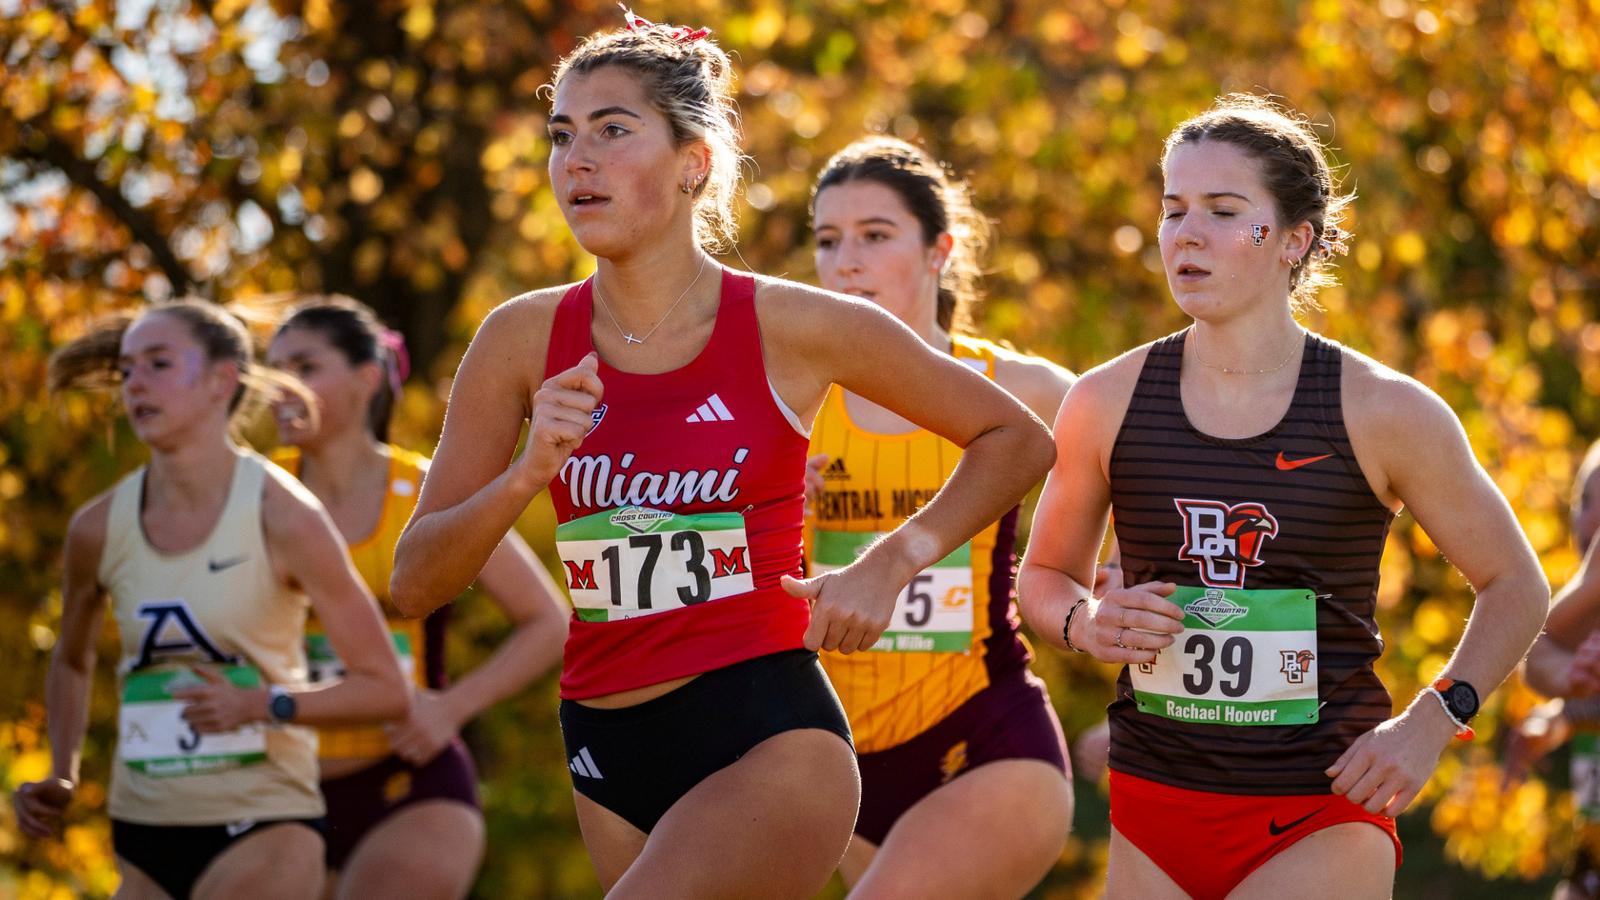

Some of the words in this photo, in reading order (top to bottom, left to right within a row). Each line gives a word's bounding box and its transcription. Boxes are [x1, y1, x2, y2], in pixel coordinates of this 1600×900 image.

[559, 448, 749, 508] Miami
[610, 514, 637, 522] CROSS
[637, 511, 673, 520] COUNTRY
[564, 560, 599, 590] M
[601, 530, 712, 610] 173
[709, 546, 748, 579] M
[1185, 605, 1210, 613] CROSS
[1210, 606, 1248, 615] COUNTRY
[1182, 633, 1254, 698] 39
[1166, 700, 1220, 721] Rachael
[1224, 705, 1278, 723] Hoover
